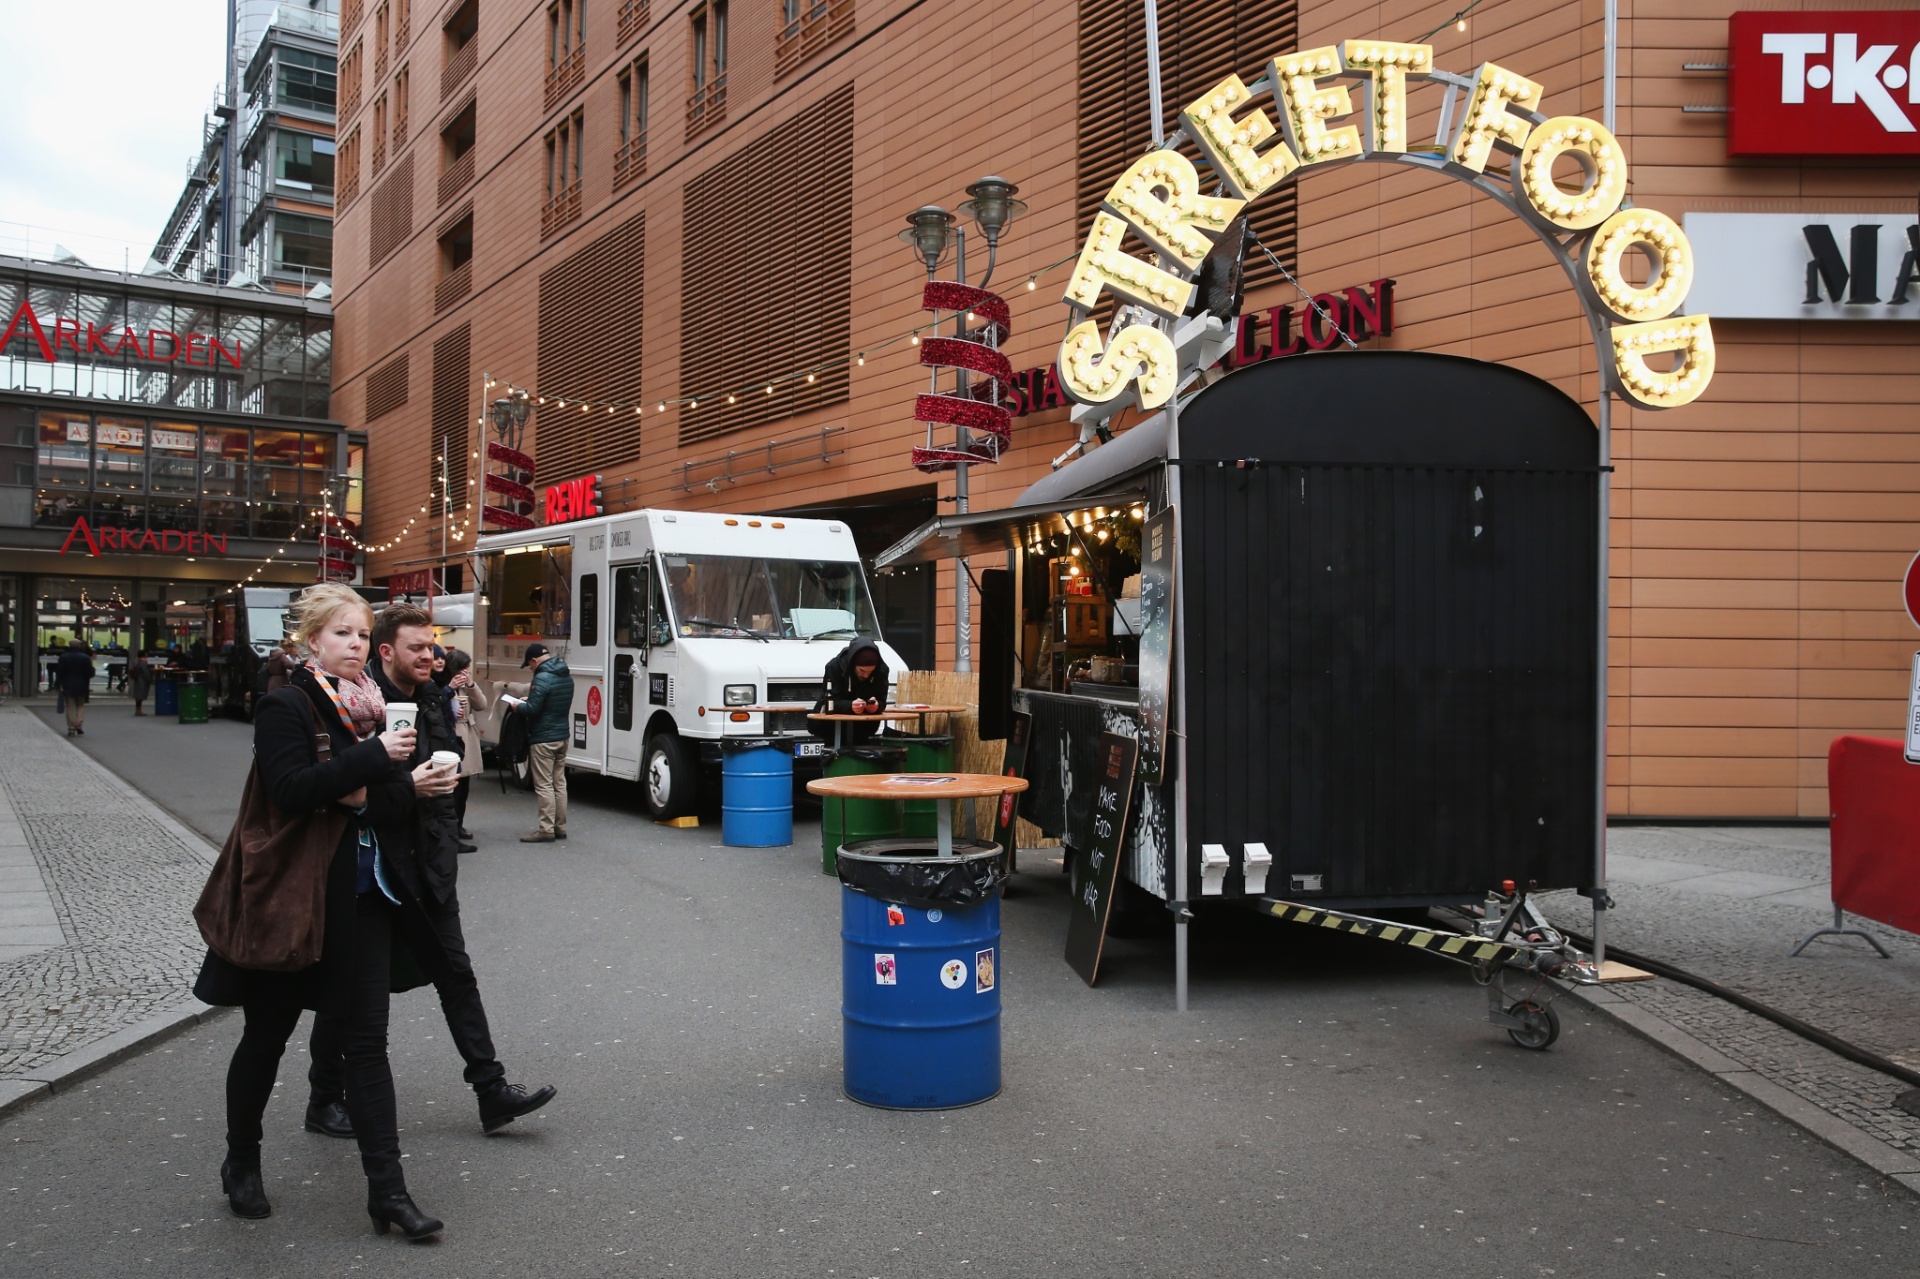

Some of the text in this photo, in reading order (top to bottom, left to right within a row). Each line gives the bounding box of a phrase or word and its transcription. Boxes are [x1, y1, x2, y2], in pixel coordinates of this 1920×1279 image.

[1058, 39, 1716, 411] STREET FOOD
[0, 300, 242, 370] ARKADEN
[545, 475, 599, 525] REWE
[59, 516, 227, 557] ARKADEN
[1094, 814, 1111, 839] FOOD
[1090, 847, 1105, 875] NOT
